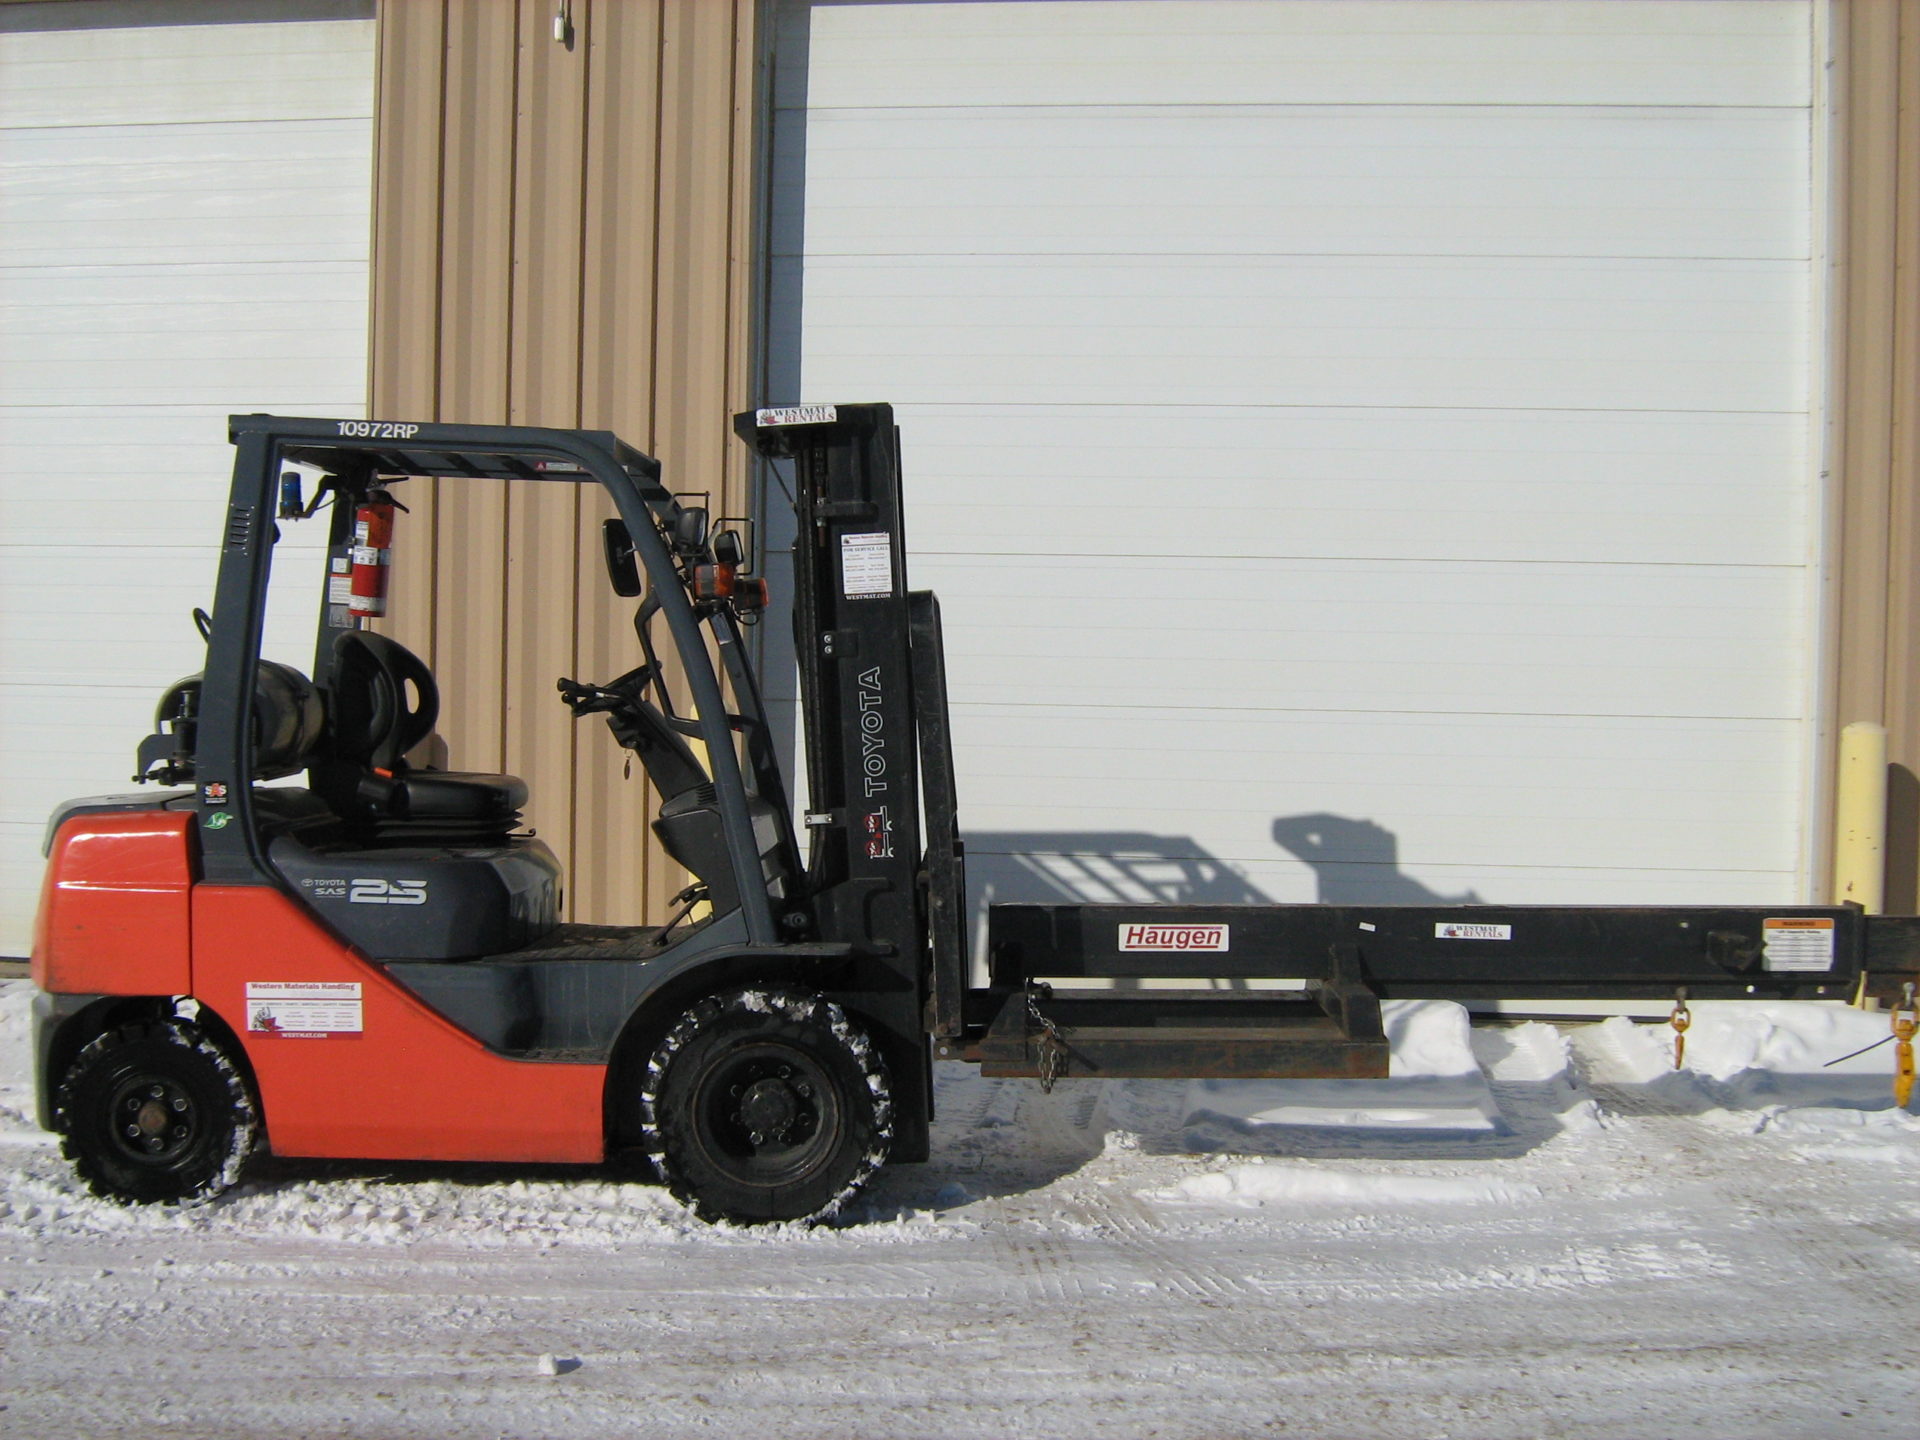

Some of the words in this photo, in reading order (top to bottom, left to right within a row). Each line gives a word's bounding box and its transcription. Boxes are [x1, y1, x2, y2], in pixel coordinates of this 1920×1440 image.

[774, 406, 825, 416] WESTMAT
[784, 413, 834, 423] RENTALS
[337, 421, 419, 439] 10972RP
[858, 666, 887, 797] TOYOTA
[349, 878, 427, 905] 25
[1126, 926, 1222, 949] Haugen
[1463, 930, 1503, 938] RENTALS
[321, 983, 355, 991] Handling
